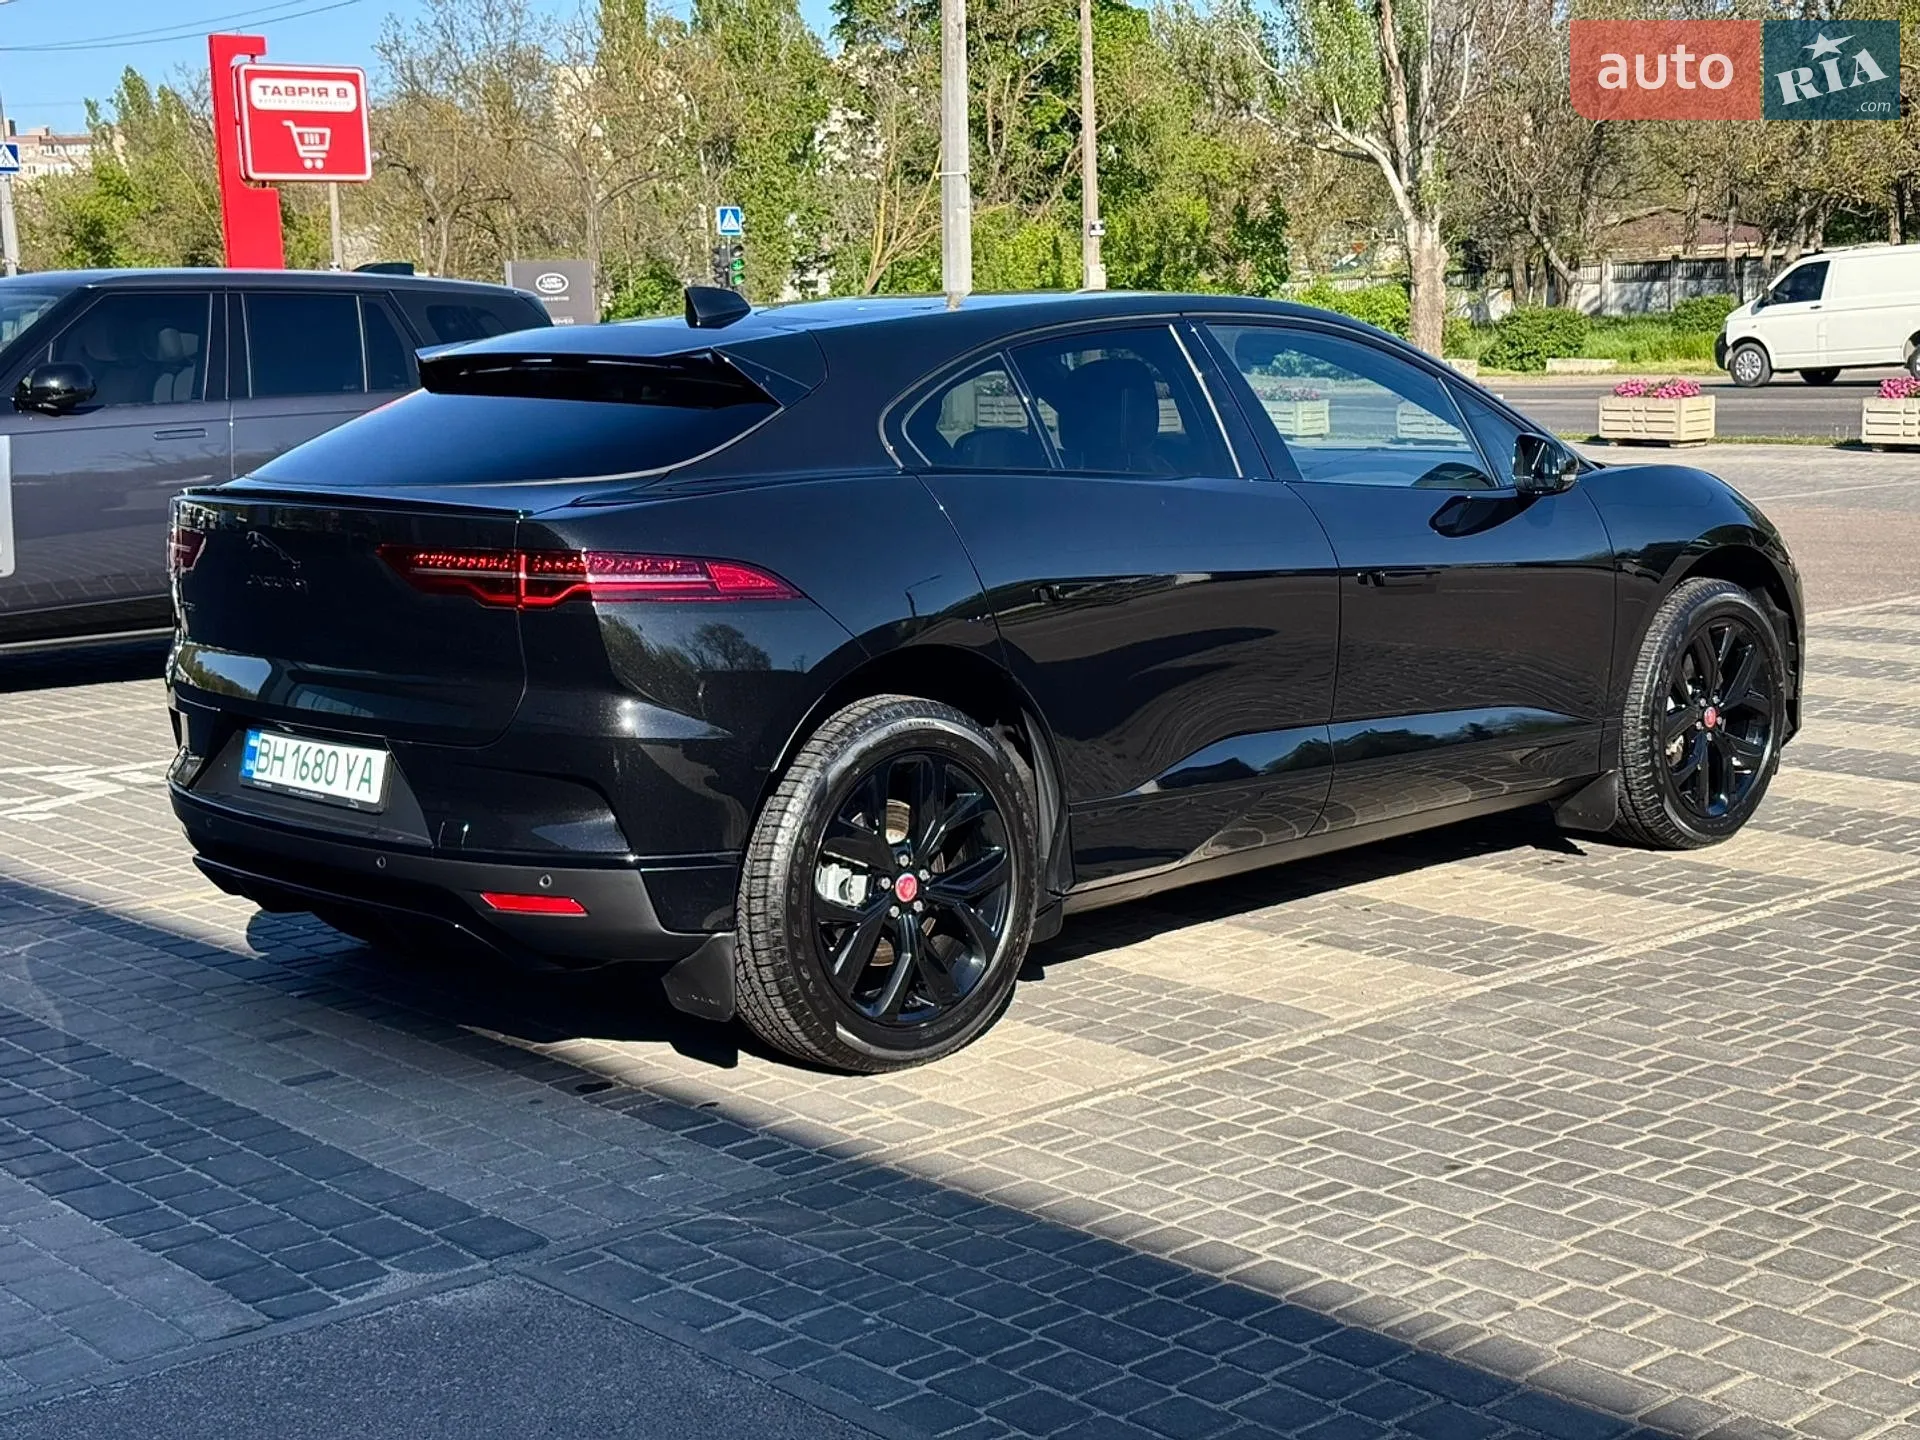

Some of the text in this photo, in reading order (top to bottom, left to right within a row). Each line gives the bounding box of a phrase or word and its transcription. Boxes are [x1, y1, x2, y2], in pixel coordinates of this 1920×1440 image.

[258, 85, 348, 98] ТАВРІЯ В
[256, 738, 372, 795] BH 1680 YA
